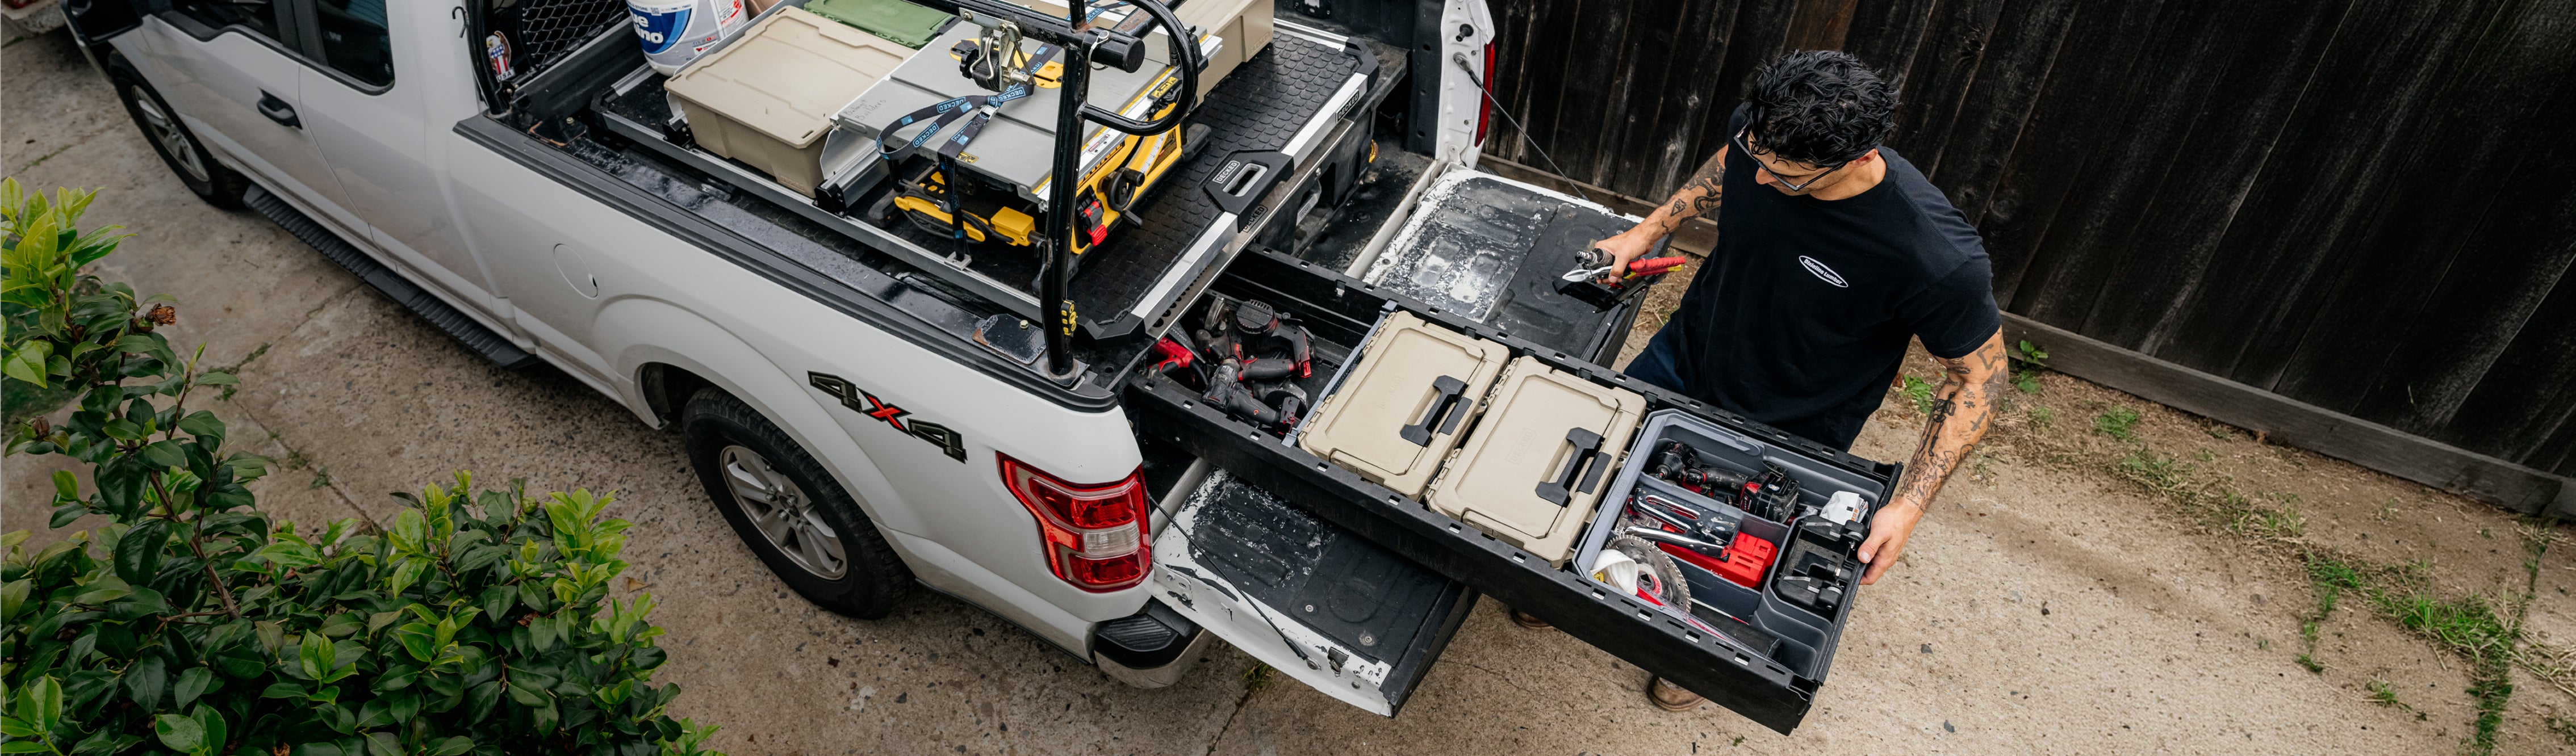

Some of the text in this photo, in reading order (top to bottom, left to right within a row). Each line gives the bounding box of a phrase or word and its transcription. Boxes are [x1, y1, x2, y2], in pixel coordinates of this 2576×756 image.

[497, 72, 511, 82] USA
[998, 89, 1024, 100] DECKED
[1338, 94, 1359, 118] DECKED
[915, 125, 938, 145] DECKED
[1216, 162, 1237, 182] DECKED
[1823, 271, 1843, 285] Lumber
